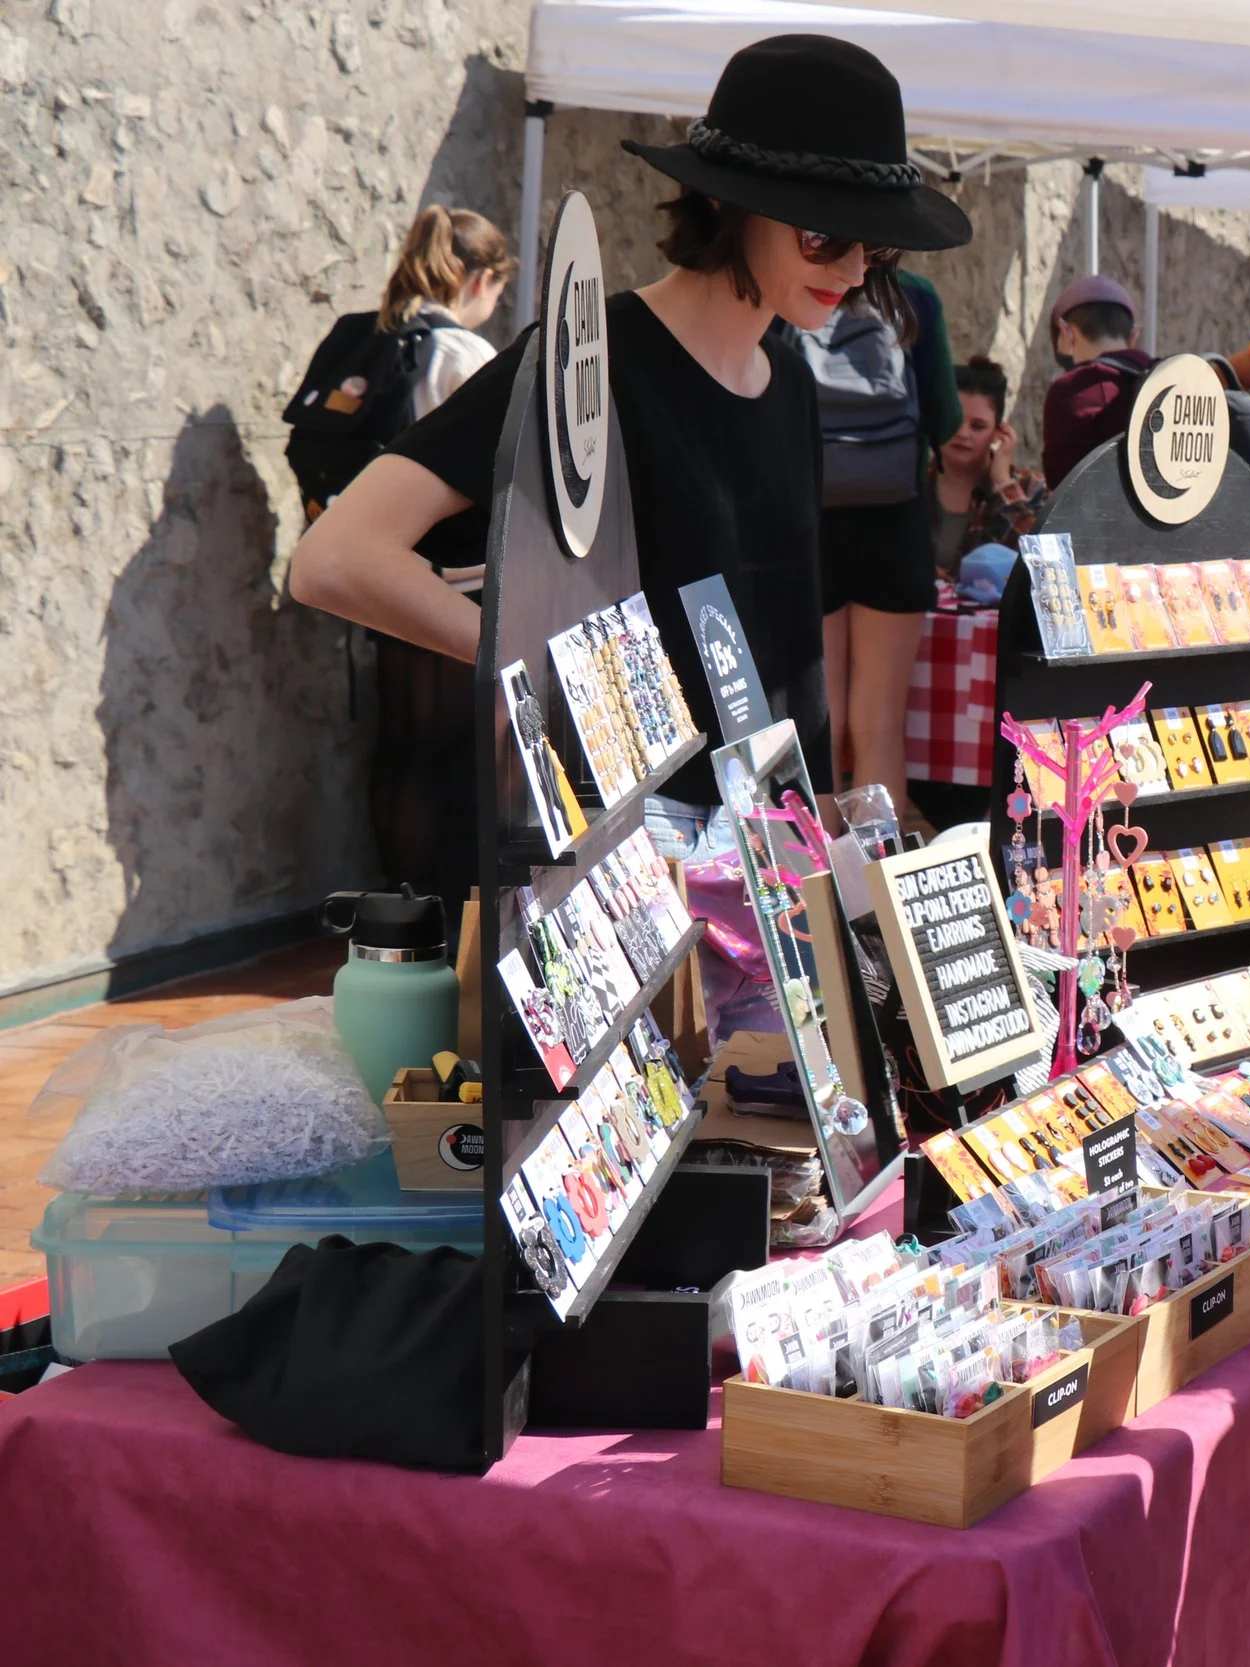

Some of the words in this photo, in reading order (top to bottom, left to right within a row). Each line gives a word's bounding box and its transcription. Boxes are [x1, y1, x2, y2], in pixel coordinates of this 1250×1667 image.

[574, 277, 600, 347] DAWN
[575, 353, 601, 427] MOON
[1173, 394, 1217, 427] DAWN
[1170, 431, 1214, 463] MOON
[709, 640, 738, 677] 15%
[896, 873, 920, 902] SUN
[918, 859, 973, 896] CATCHERS
[970, 856, 985, 880] &
[904, 897, 943, 928] CLIP-ON
[947, 883, 991, 916] PIERCED
[926, 915, 985, 953] EARRINGS
[935, 949, 1000, 990] HANDMADE
[944, 984, 1011, 1028] INSTAGRAM
[1088, 1127, 1130, 1157] HOLOGRAPHIC
[1098, 1146, 1124, 1168] STICKERS
[1111, 1168, 1124, 1183] each
[1124, 1180, 1134, 1190] two
[1202, 1289, 1226, 1313] CLIP-ON
[1047, 1378, 1078, 1407] CLIP-ON
